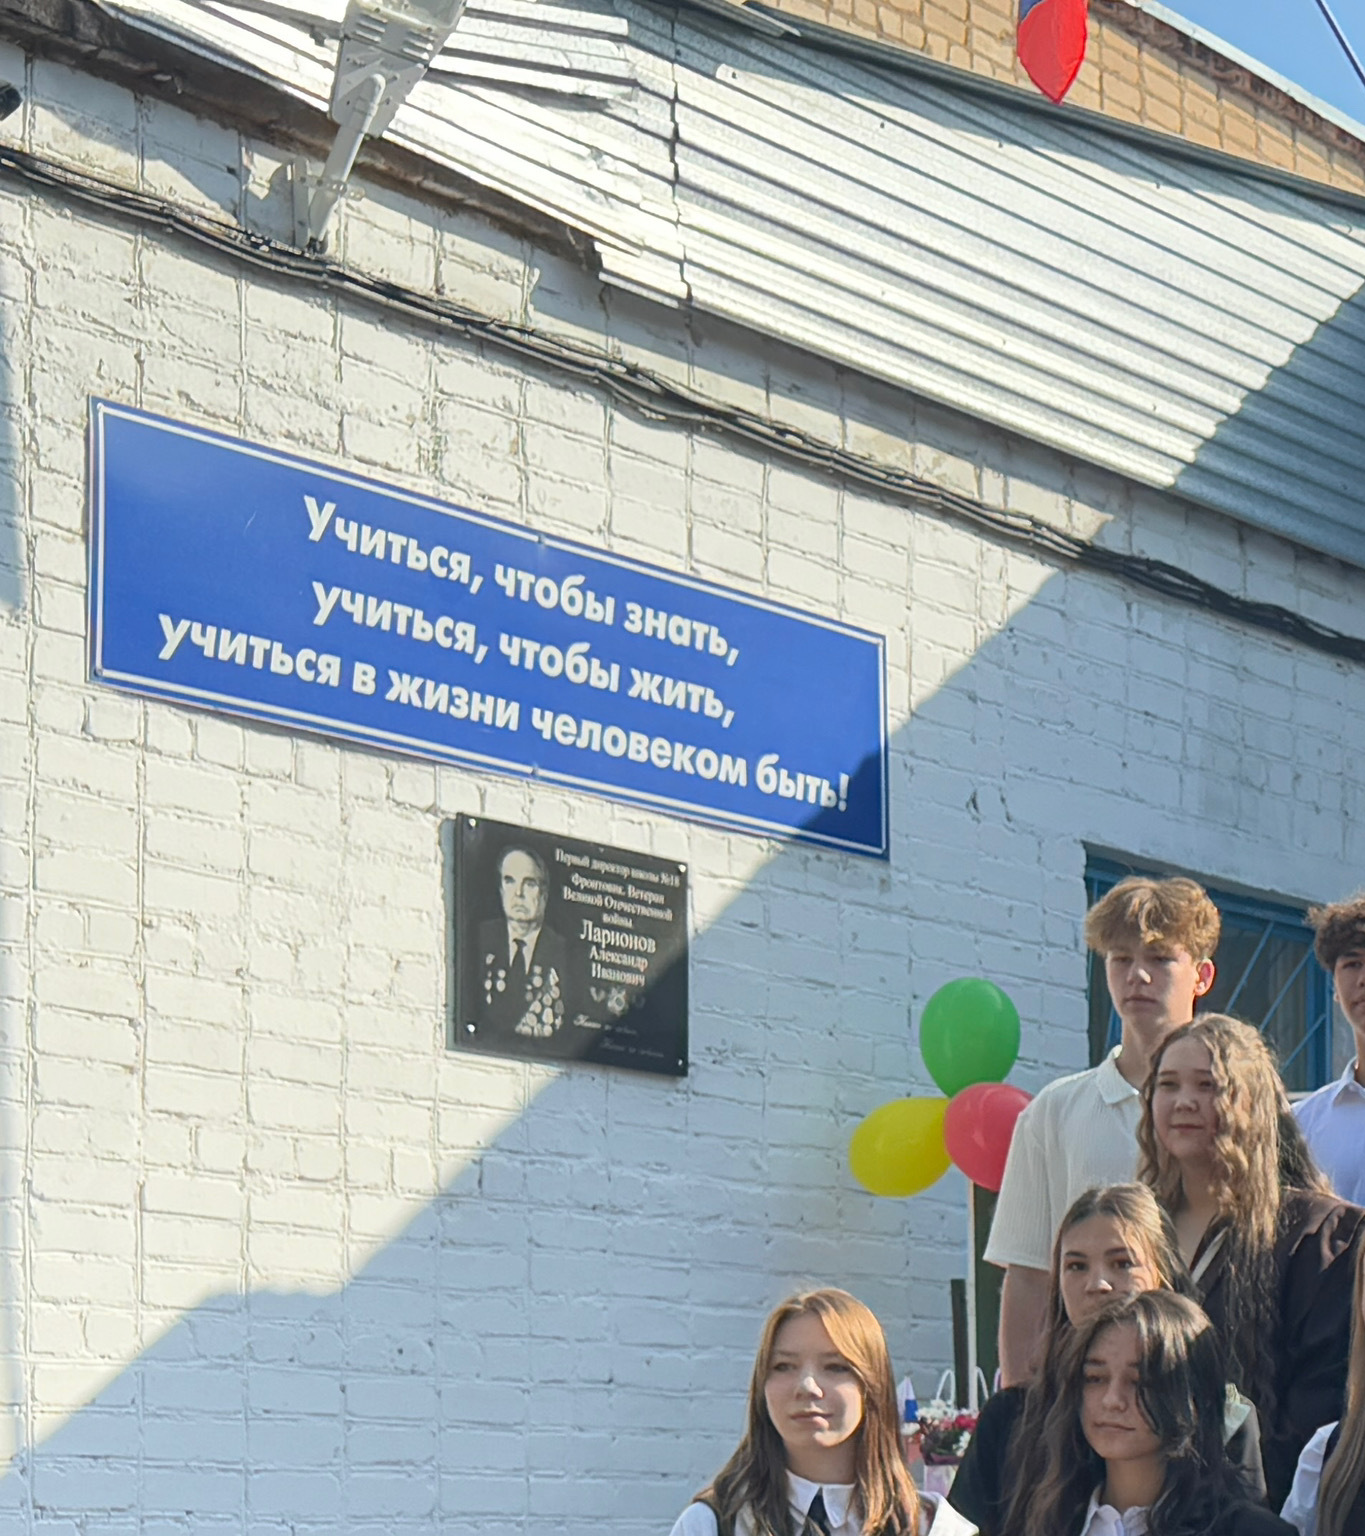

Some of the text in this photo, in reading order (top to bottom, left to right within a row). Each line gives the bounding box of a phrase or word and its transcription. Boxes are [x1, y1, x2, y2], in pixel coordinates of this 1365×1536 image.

[303, 494, 742, 667] Учиться, чтобы знать,
[312, 581, 736, 727] учиться, чтобы жить,
[158, 613, 850, 813] учиться в жизни человеком быть!
[580, 918, 656, 953] Ларионов
[589, 945, 648, 972] Александр
[591, 962, 645, 987] Иванович
